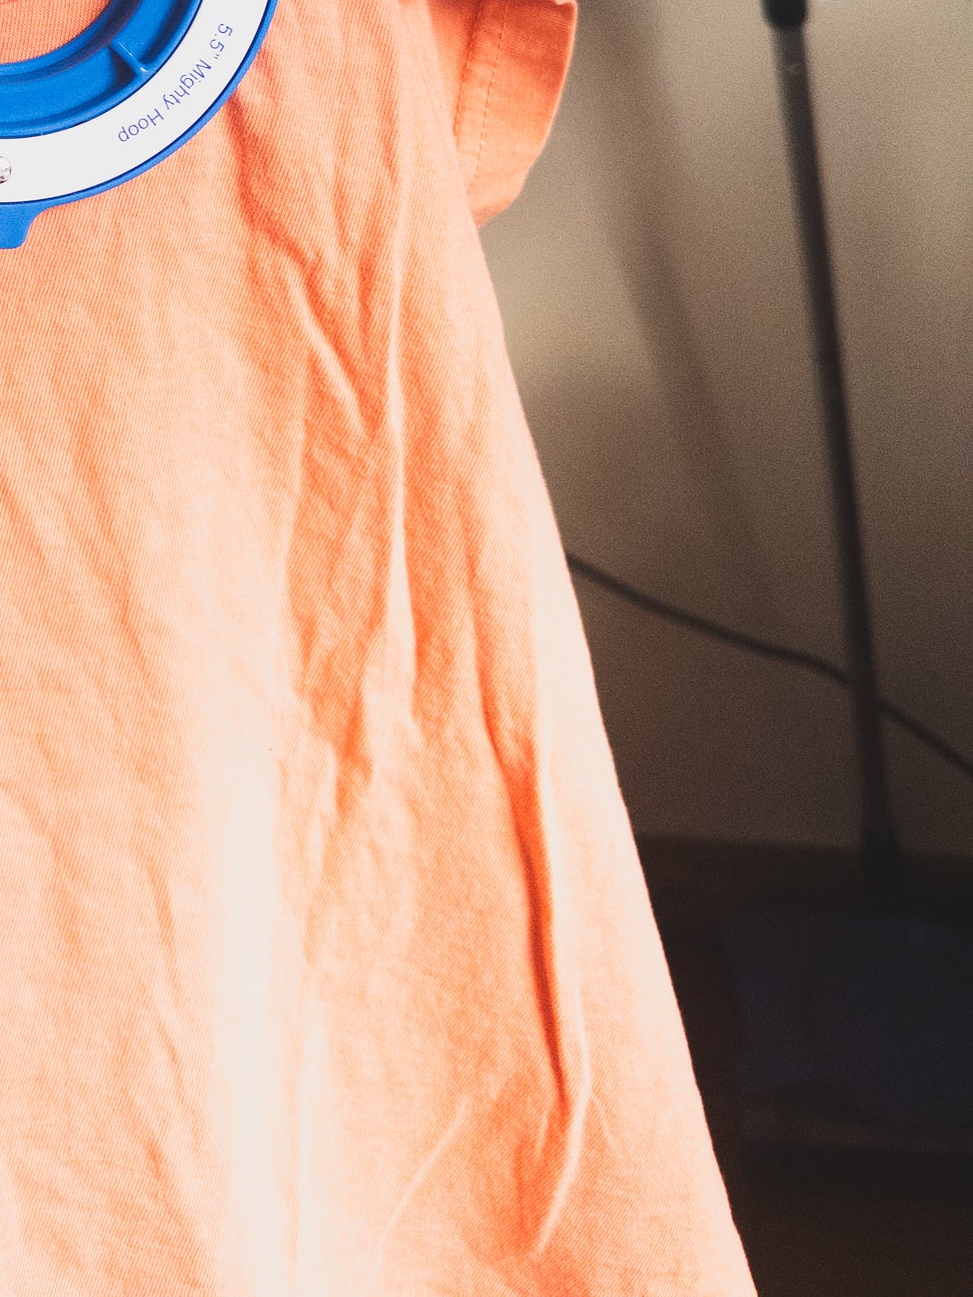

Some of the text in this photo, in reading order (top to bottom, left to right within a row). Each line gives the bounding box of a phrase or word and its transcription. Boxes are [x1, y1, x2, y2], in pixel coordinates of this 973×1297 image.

[118, 23, 233, 142] 5.5" Mighty Hoop
